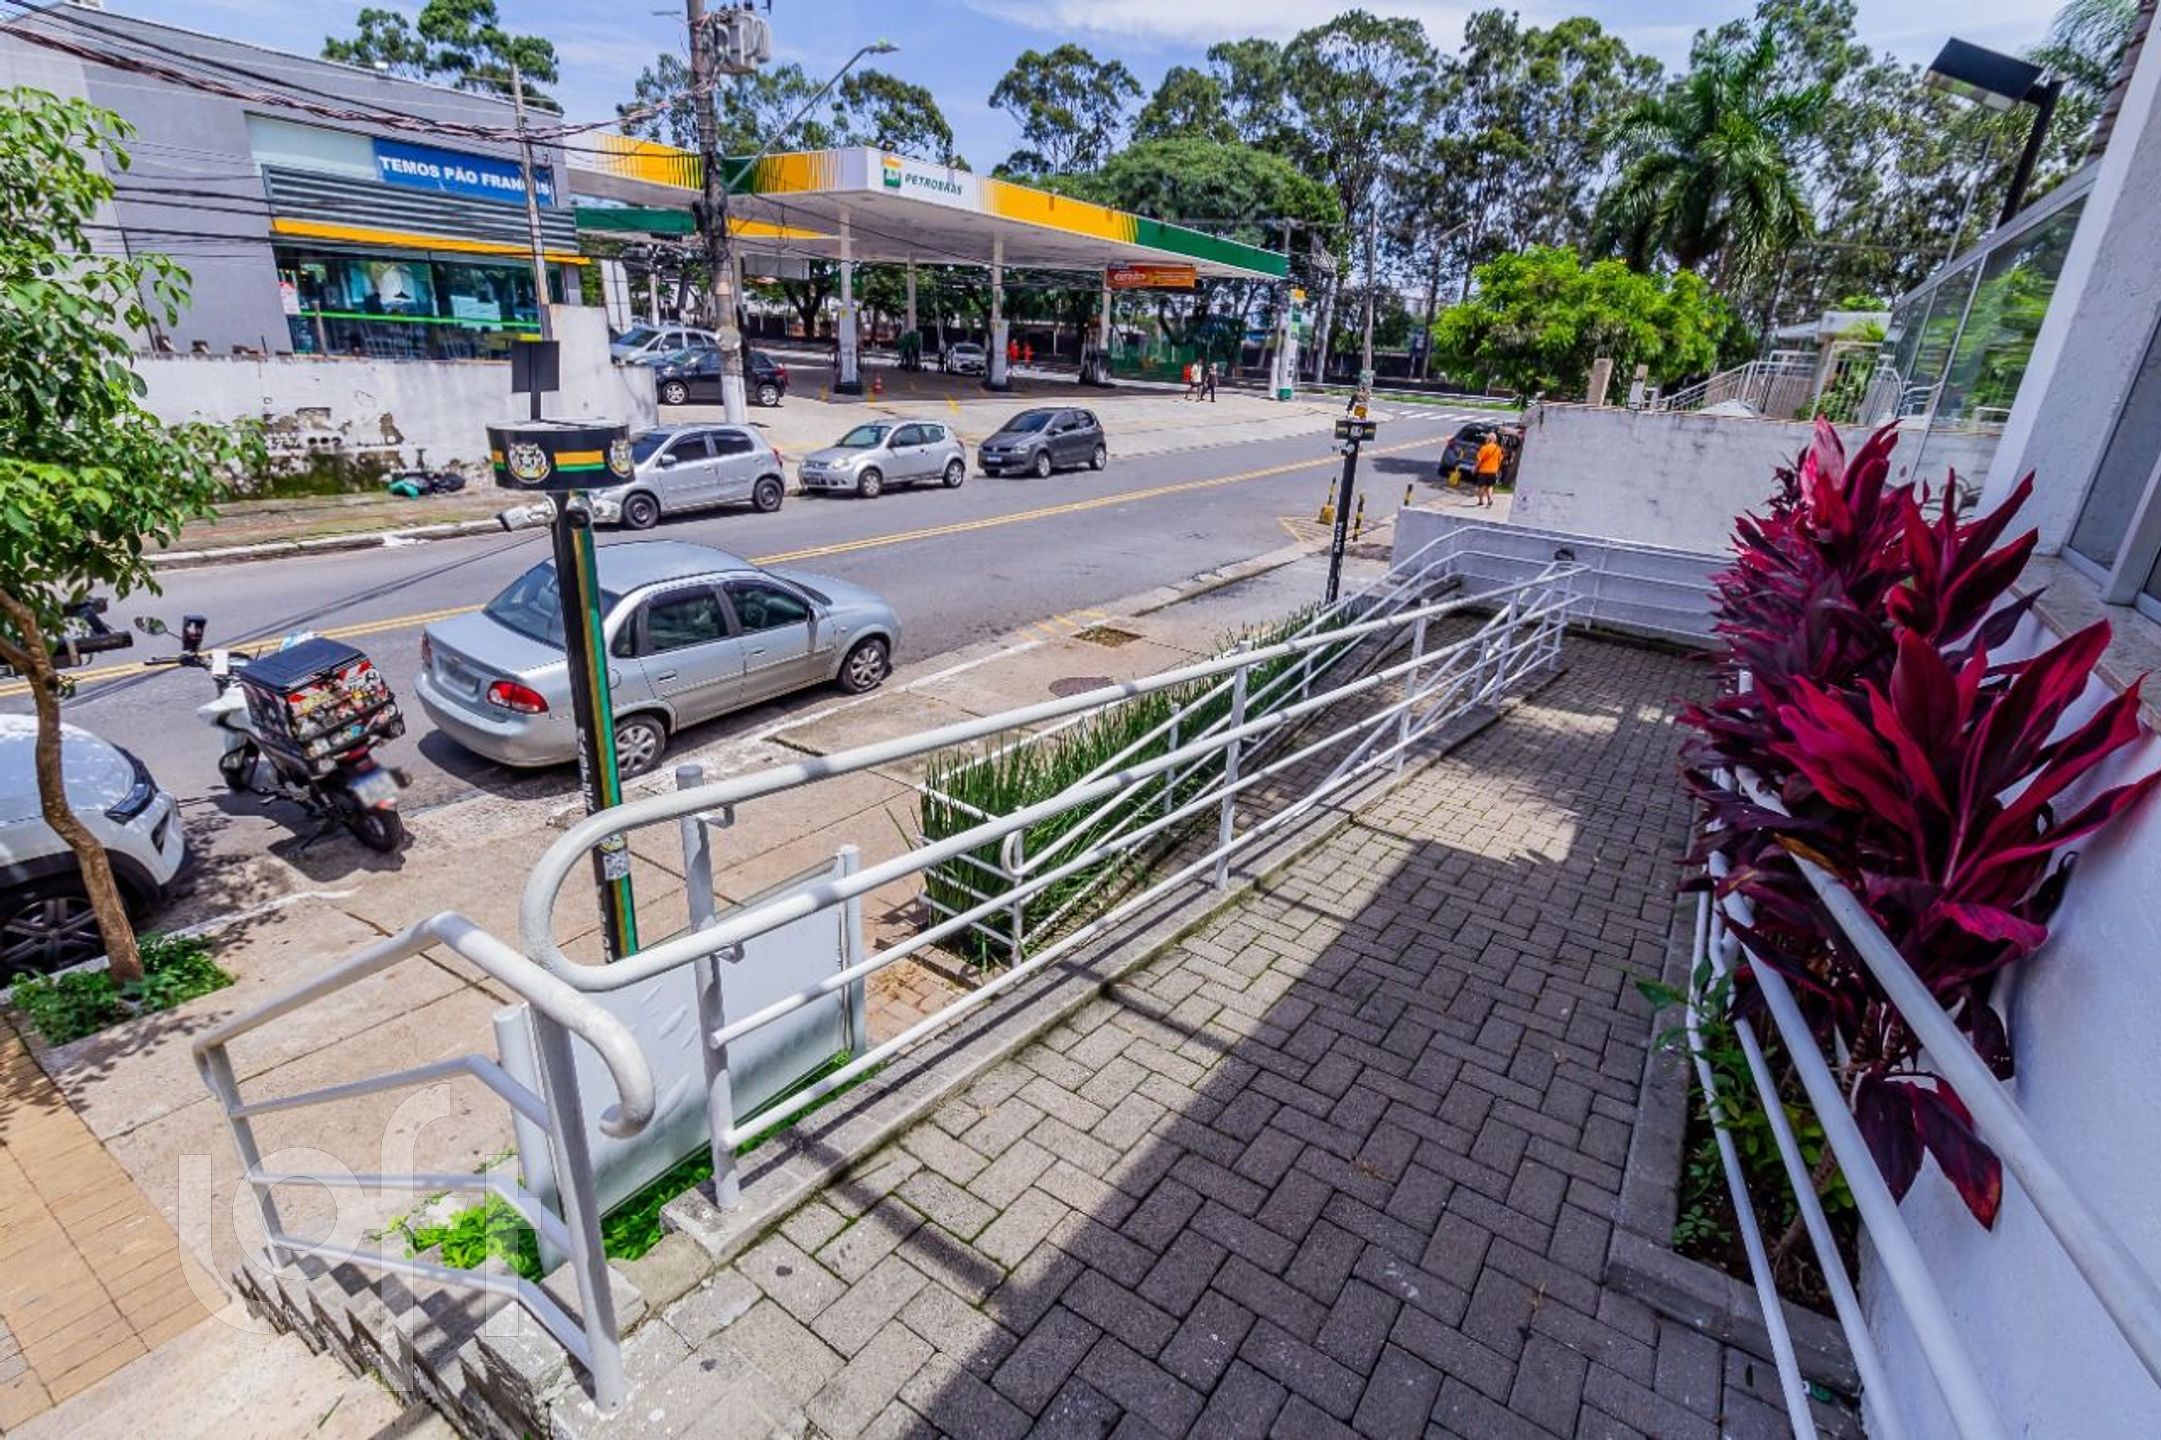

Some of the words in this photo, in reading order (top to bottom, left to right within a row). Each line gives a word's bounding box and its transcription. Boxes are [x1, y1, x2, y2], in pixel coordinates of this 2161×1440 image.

[378, 155, 440, 178] TEMOS
[443, 166, 478, 184] PÃO
[481, 173, 550, 196] FRANS
[905, 173, 962, 195] PETROBRAS
